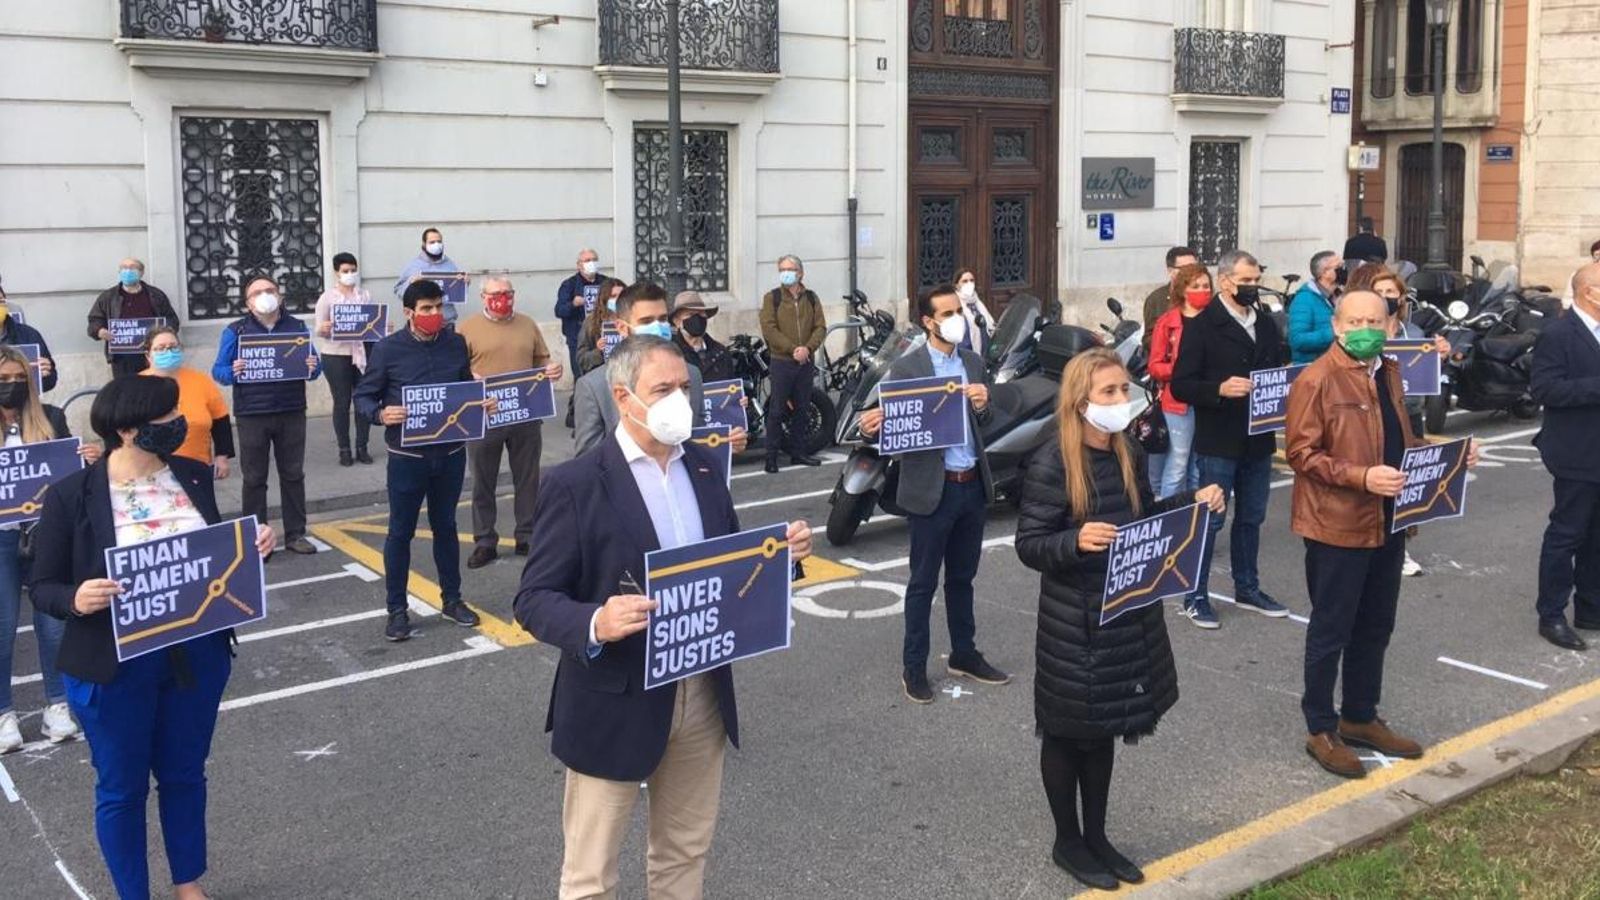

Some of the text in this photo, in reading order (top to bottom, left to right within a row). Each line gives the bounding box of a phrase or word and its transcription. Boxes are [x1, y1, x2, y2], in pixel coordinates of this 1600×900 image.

[1086, 166, 1152, 198] the River
[335, 305, 362, 314] FINAN
[111, 320, 138, 328] FINAN
[335, 322, 357, 331] JUST
[242, 347, 276, 358] INVER
[241, 368, 284, 380] JUSTES
[1253, 370, 1287, 388] FINAN
[406, 386, 447, 402] DEUTE
[1253, 384, 1292, 402] ÇAMEN
[406, 398, 444, 416] HISTÒ
[498, 398, 519, 411] ONS
[884, 399, 924, 418] INVER
[1252, 400, 1280, 416] JUST
[406, 416, 427, 430] RIC
[490, 408, 530, 424] JUSTES
[884, 416, 922, 434] SIONS
[883, 430, 933, 450] JUSTES
[1405, 446, 1444, 469] FINAN
[1405, 462, 1448, 486] AMENT
[1396, 484, 1426, 506] JUST
[1114, 519, 1162, 552] FINAN
[114, 538, 188, 575] FINAN
[1108, 564, 1146, 595] JUST
[654, 576, 722, 618] INVER
[119, 590, 180, 626] JUST
[654, 607, 719, 648] SIONS
[652, 630, 736, 678] JUSTES
